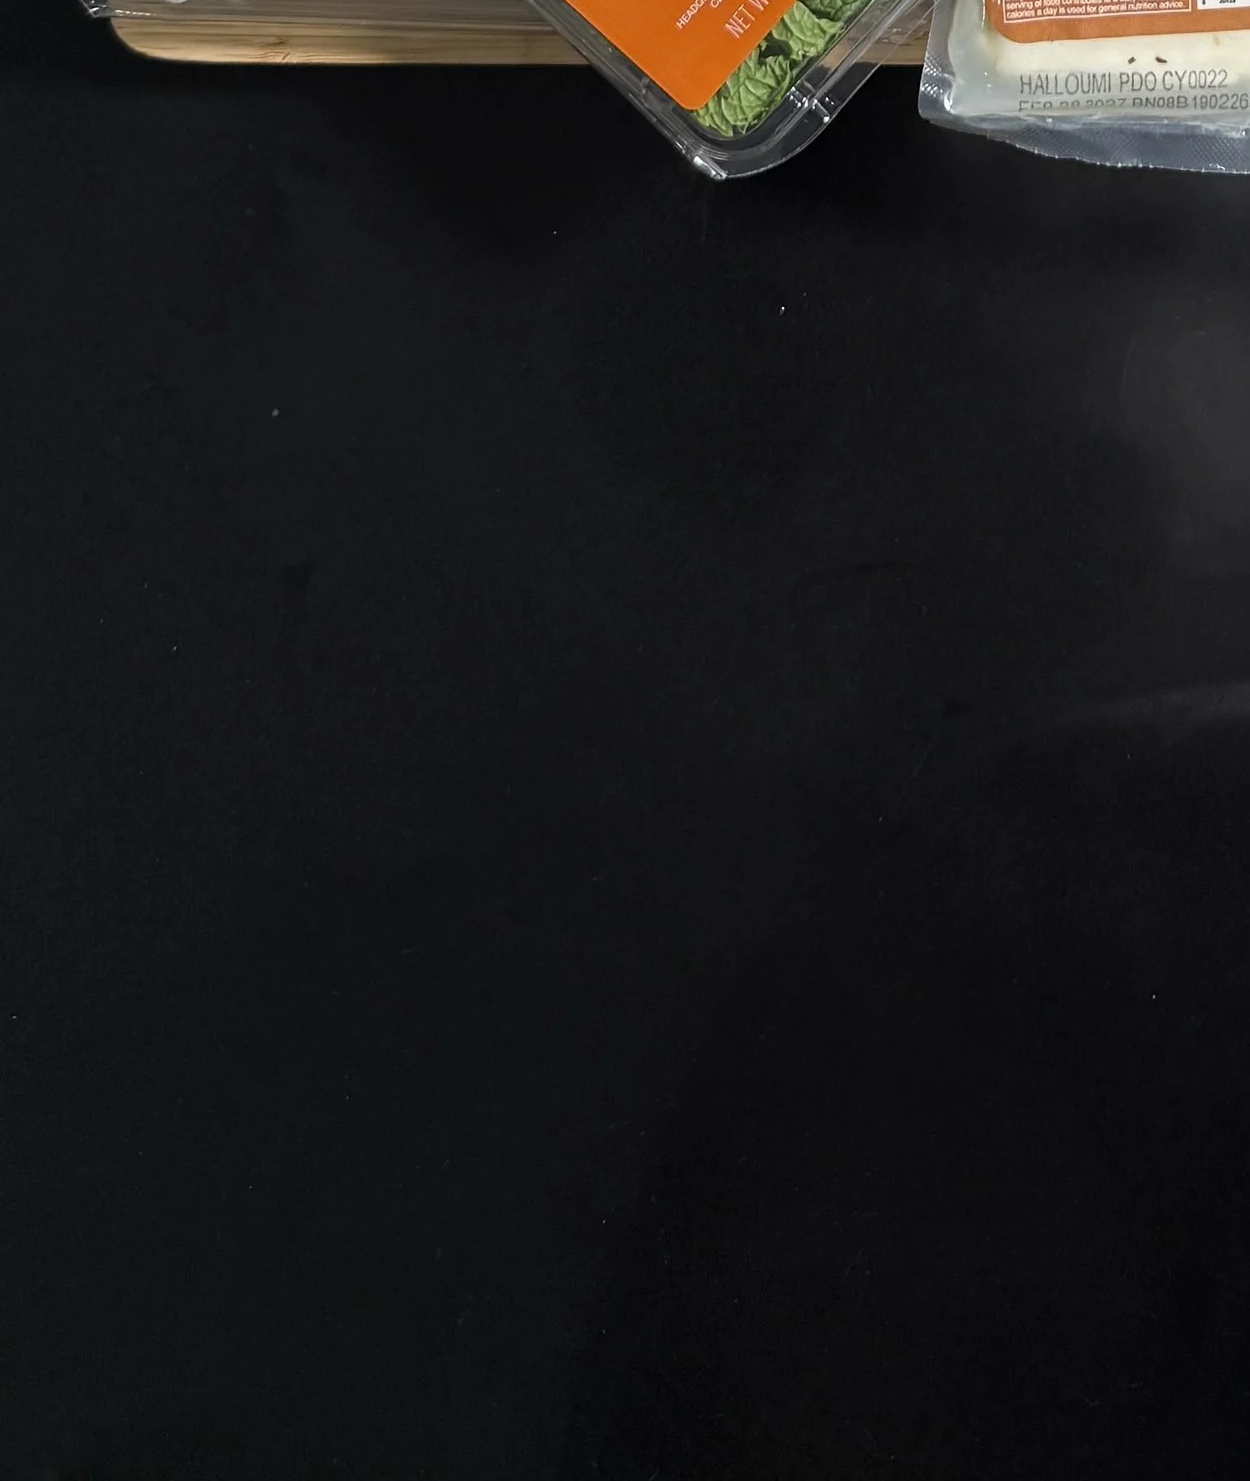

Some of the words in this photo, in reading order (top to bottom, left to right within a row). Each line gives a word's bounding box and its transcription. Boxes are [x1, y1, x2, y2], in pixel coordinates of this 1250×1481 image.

[723, 4, 759, 39] NET
[1019, 72, 1111, 95] HALLOUMI
[1119, 71, 1157, 92] PDO
[1162, 69, 1227, 90] CY0022
